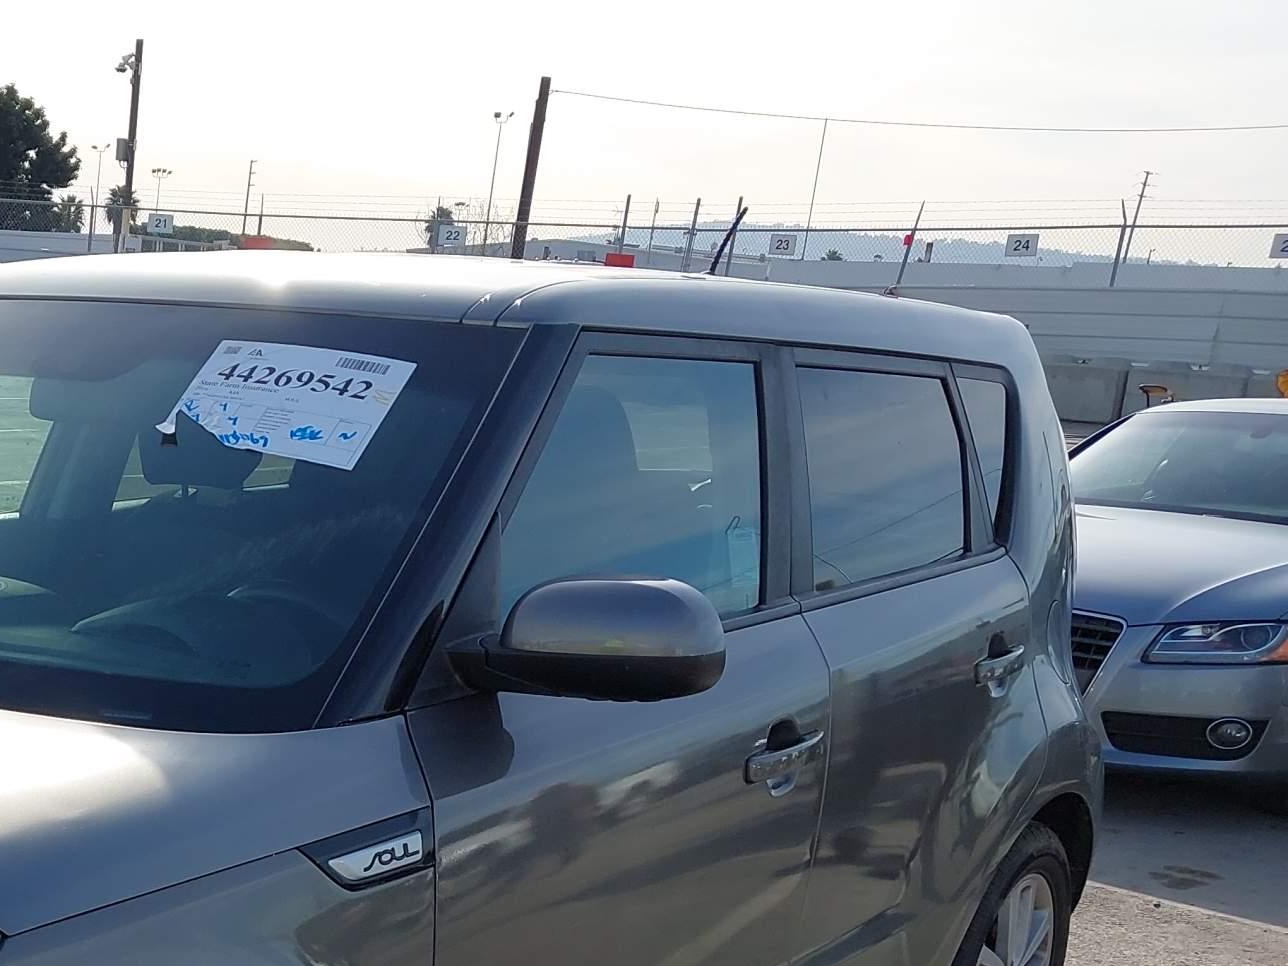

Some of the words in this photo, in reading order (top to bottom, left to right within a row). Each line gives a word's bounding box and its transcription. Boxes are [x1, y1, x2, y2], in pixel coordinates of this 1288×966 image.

[154, 218, 167, 228] 21
[445, 230, 460, 241] 22
[775, 239, 790, 250] 23
[1013, 239, 1030, 251] 24
[217, 362, 373, 400] 44269542
[219, 381, 240, 389] Farm
